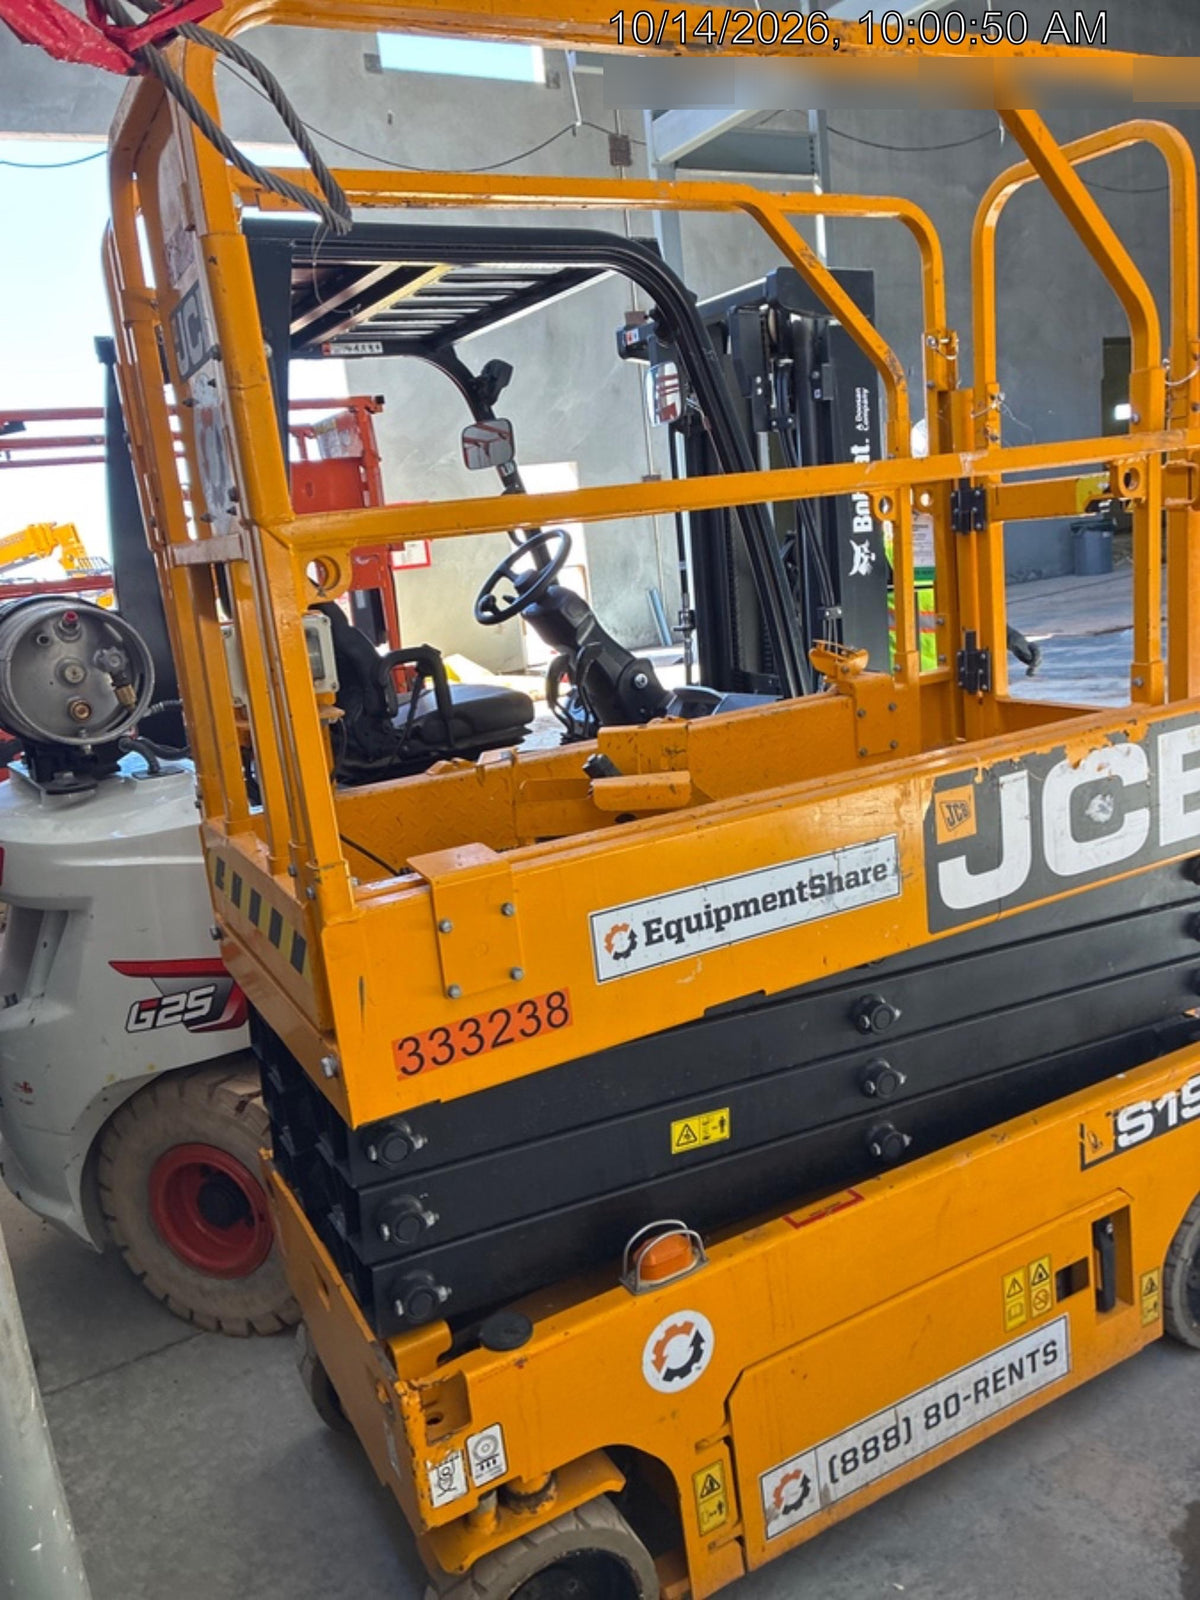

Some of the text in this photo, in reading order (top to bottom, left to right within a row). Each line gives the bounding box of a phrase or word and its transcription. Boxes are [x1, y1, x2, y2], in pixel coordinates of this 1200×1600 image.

[862, 387, 871, 431] Company
[642, 862, 888, 947] EquipmentShare
[397, 990, 570, 1076] 333238
[828, 1340, 1058, 1484] (888) 80-RENTS
